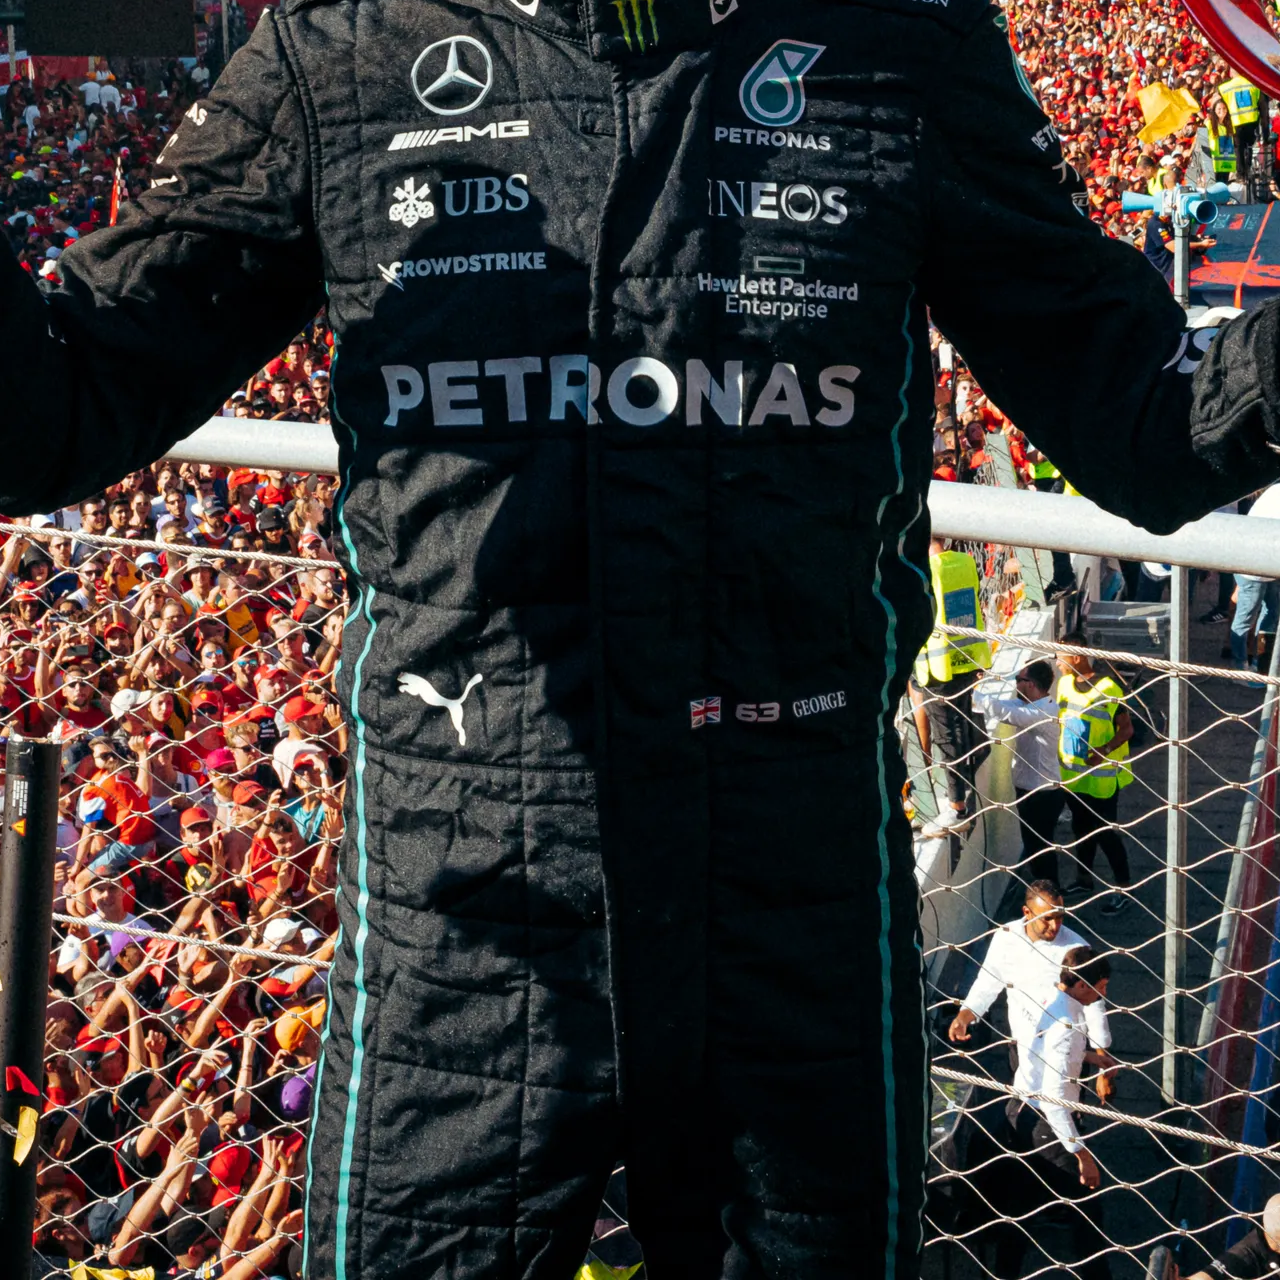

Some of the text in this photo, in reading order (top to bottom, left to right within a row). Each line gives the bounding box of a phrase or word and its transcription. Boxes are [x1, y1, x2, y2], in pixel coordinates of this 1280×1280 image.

[430, 120, 530, 147] AMG
[714, 126, 831, 151] PETRONAS
[442, 174, 530, 217] UBS
[706, 178, 848, 224] INEOS
[387, 251, 547, 280] CROWDSTRIKE
[697, 272, 859, 302] Hewlett Packard
[725, 293, 829, 320] Enterprise
[381, 355, 862, 427] PETRONAS
[735, 690, 848, 722] 63 GEORGE
